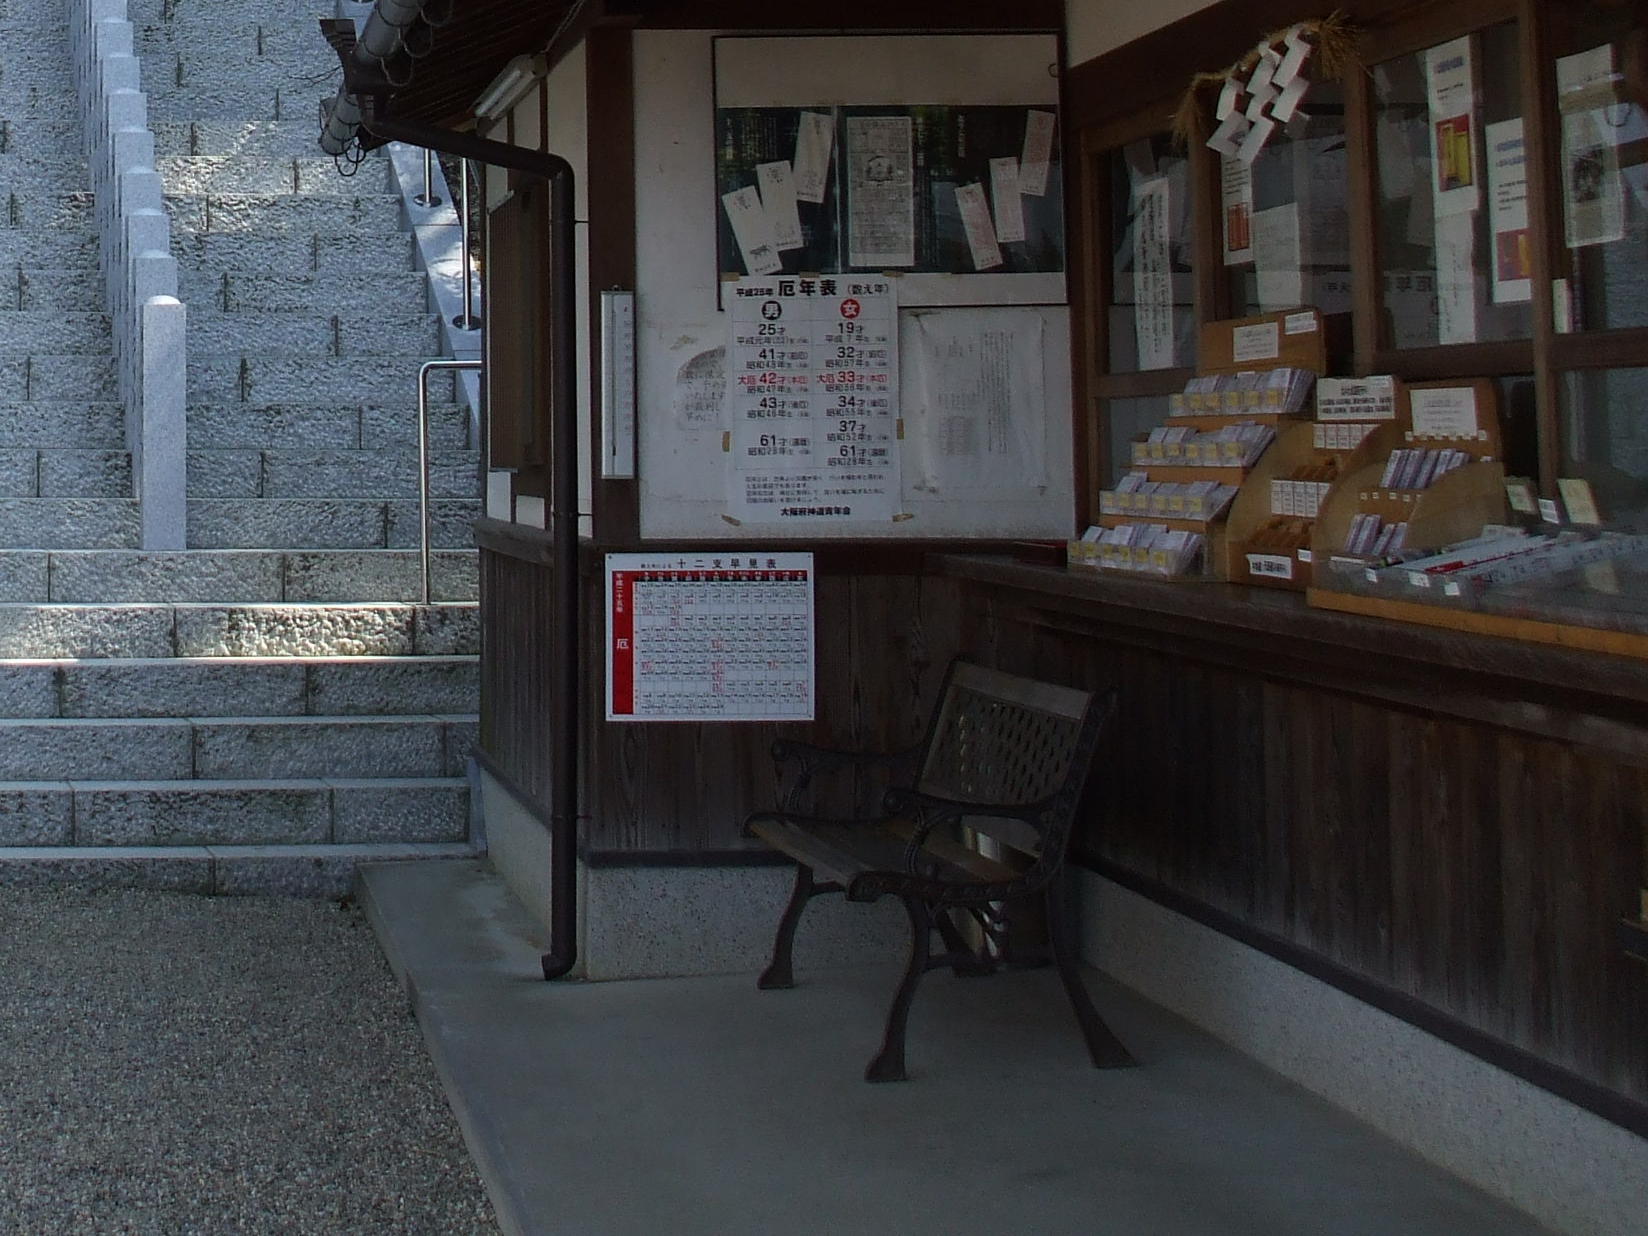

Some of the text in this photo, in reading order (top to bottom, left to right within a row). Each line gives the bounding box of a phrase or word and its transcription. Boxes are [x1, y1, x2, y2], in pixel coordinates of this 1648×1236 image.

[778, 279, 837, 297] 厄年表
[763, 300, 859, 319] 男 女
